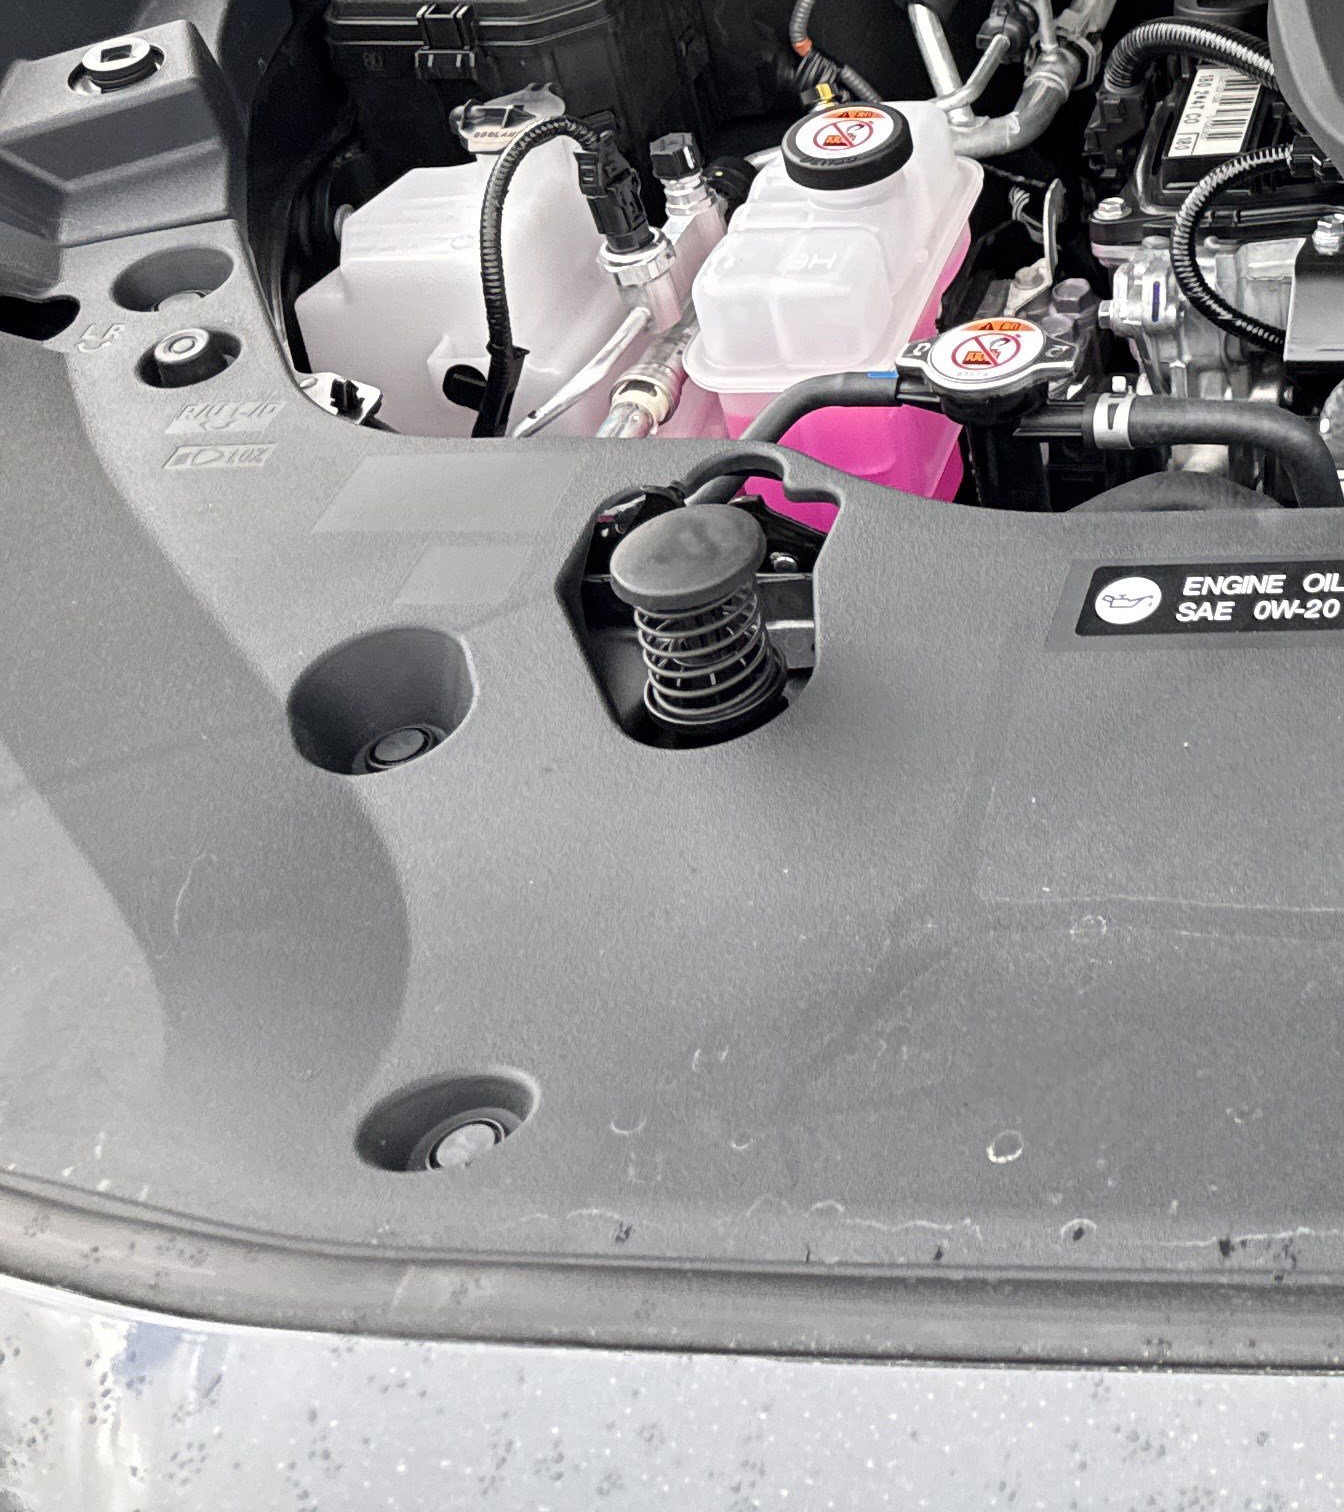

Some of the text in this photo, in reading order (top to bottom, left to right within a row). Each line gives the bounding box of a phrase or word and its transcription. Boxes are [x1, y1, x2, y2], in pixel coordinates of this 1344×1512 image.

[1182, 573, 1287, 597] ENGINE
[1175, 597, 1342, 622] SAE 0W-20
